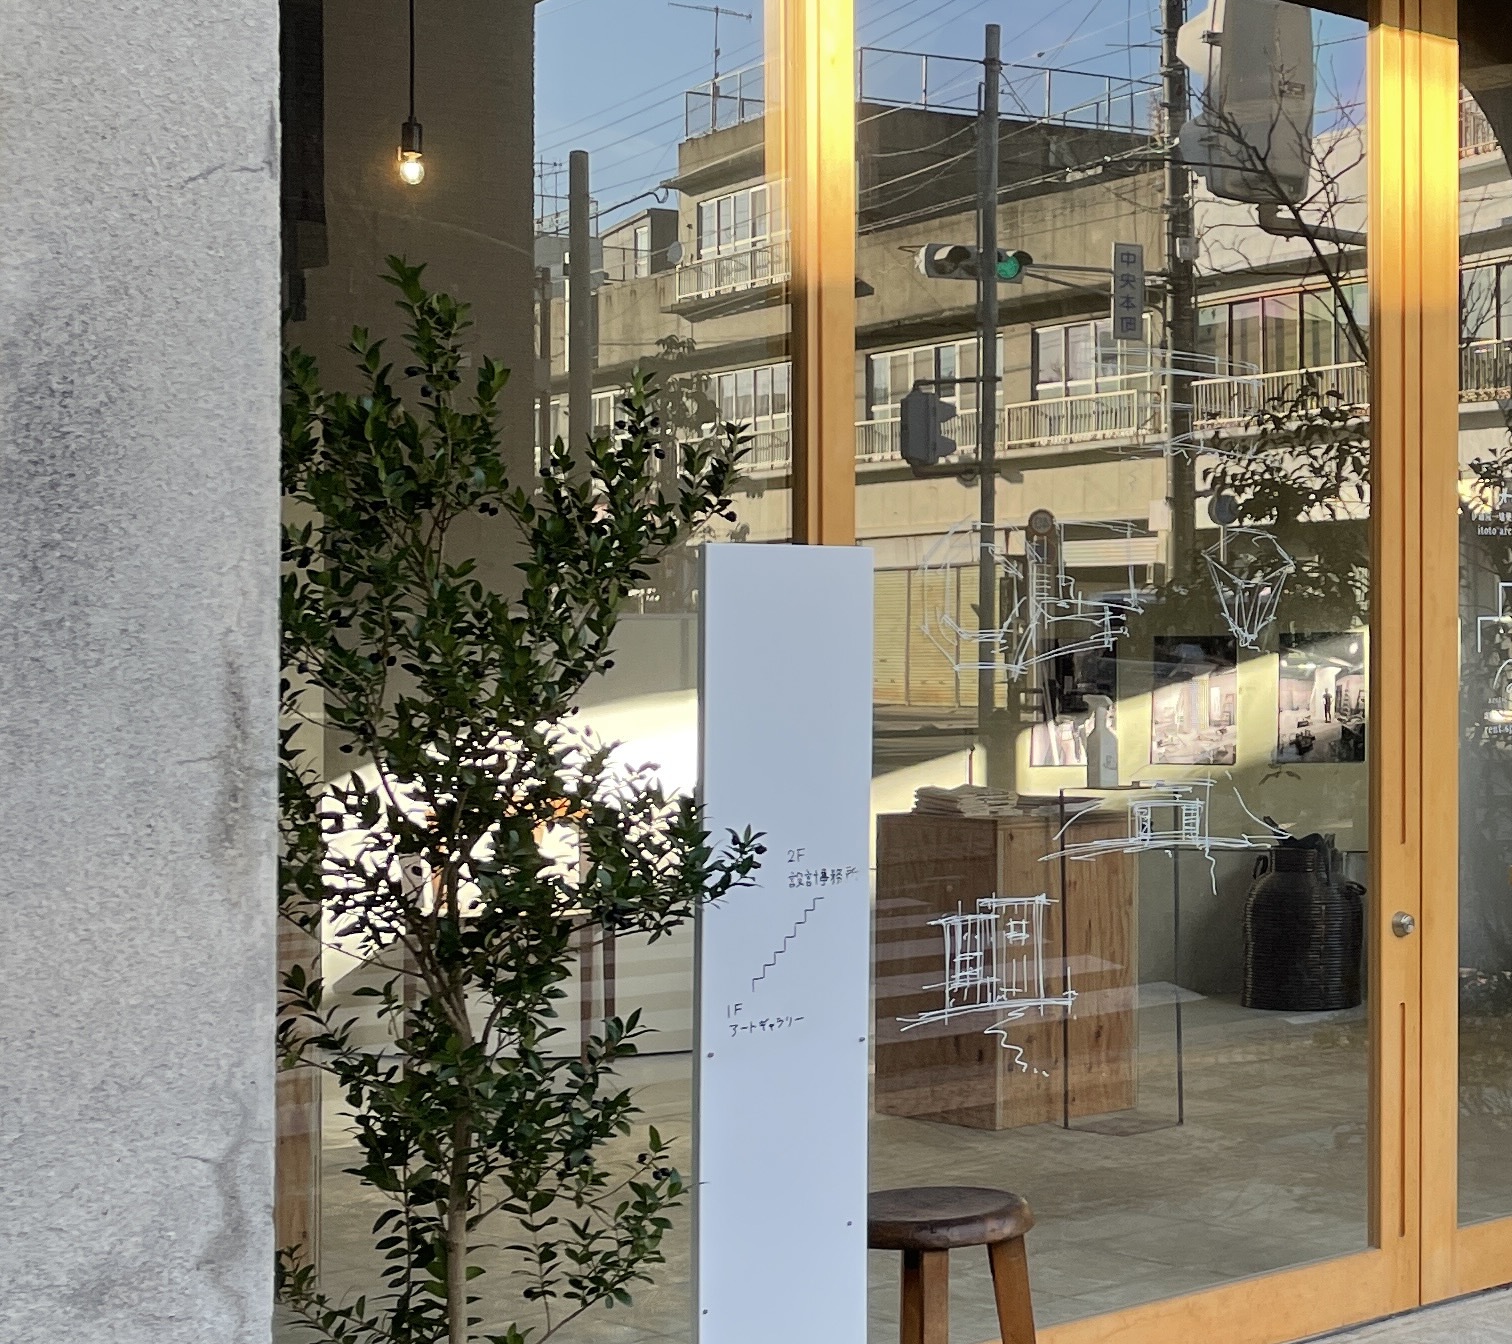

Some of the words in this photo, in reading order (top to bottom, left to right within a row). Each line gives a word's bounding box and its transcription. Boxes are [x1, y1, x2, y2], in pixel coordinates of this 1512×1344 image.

[787, 847, 806, 863] 2F
[788, 865, 859, 888] 設計事務所
[727, 1002, 743, 1018] 1F
[728, 1016, 805, 1037] アートギャラリー
